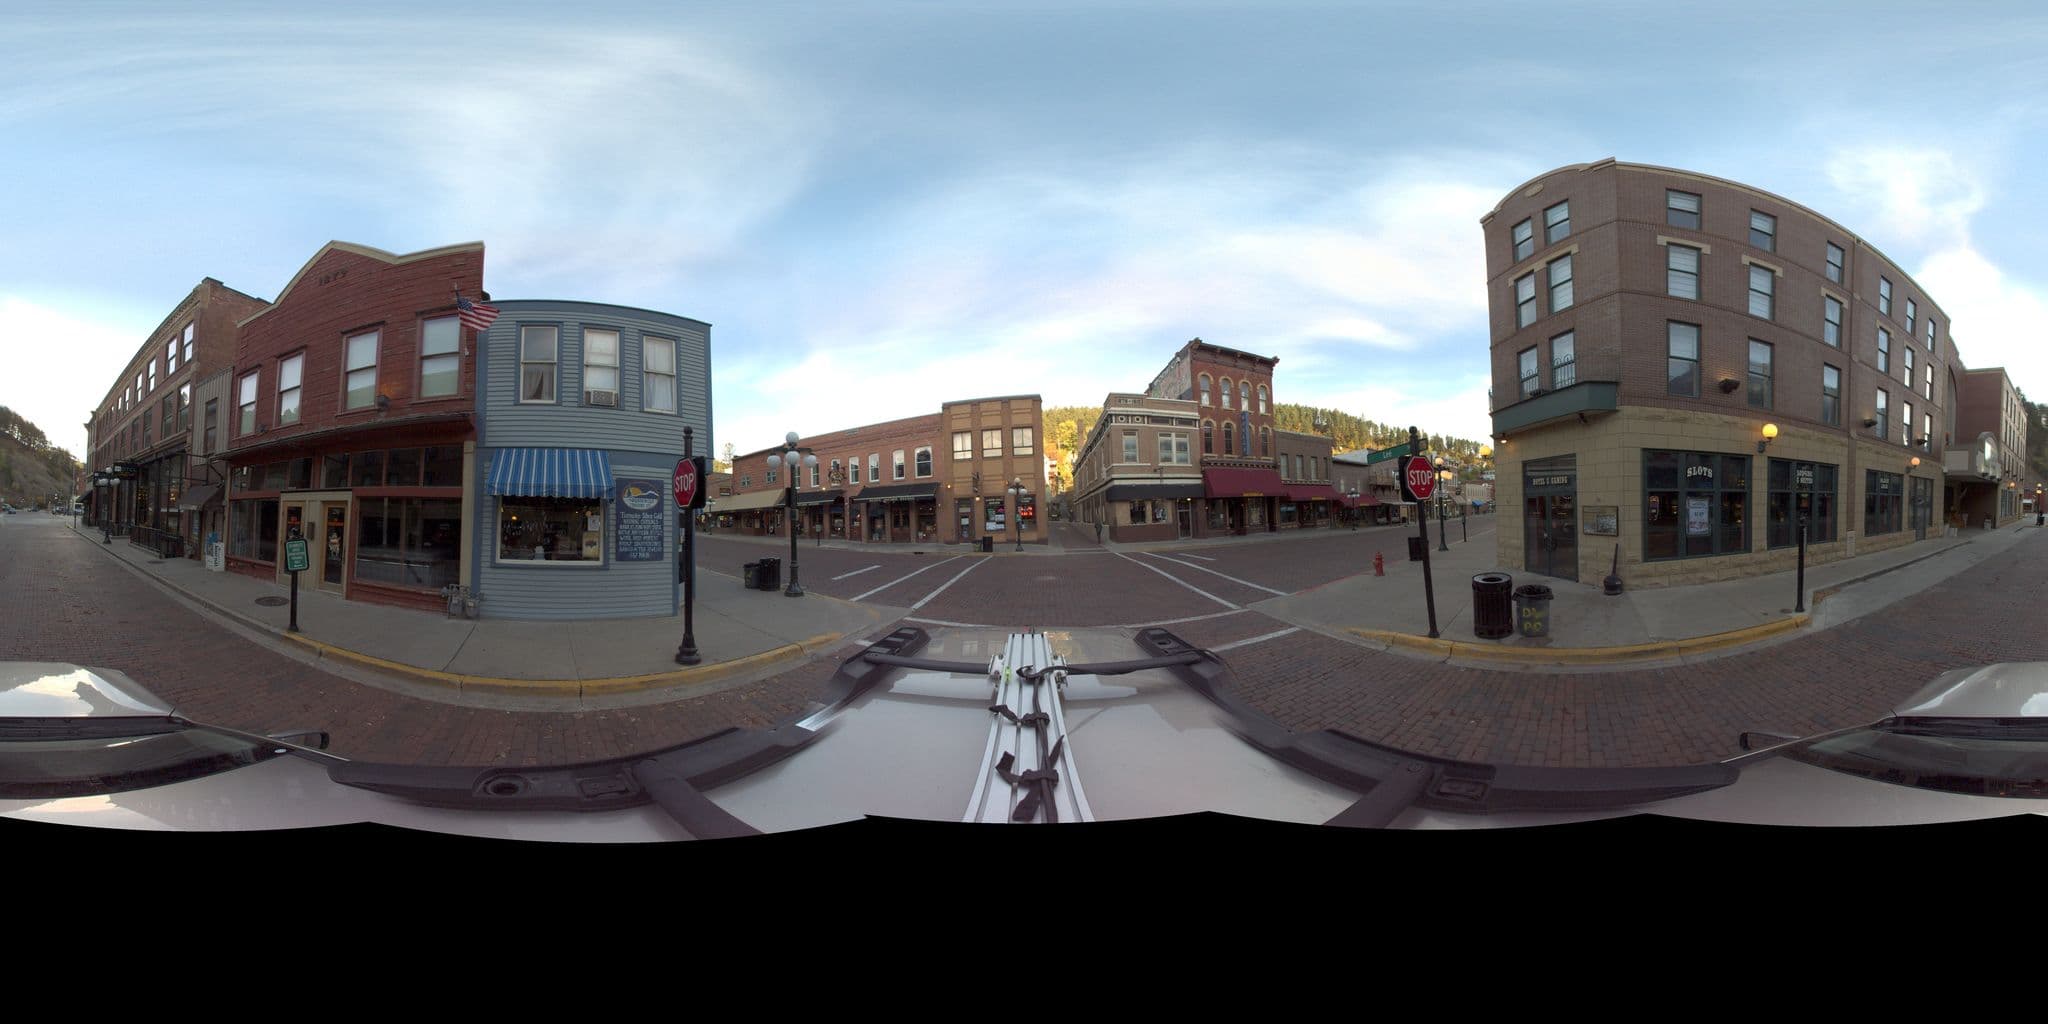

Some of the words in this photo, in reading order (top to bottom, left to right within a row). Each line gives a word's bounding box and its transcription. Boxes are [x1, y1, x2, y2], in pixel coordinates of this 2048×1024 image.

[1410, 470, 1433, 485] STOP
[1687, 466, 1713, 478] SLOTS
[675, 473, 694, 493] STOP
